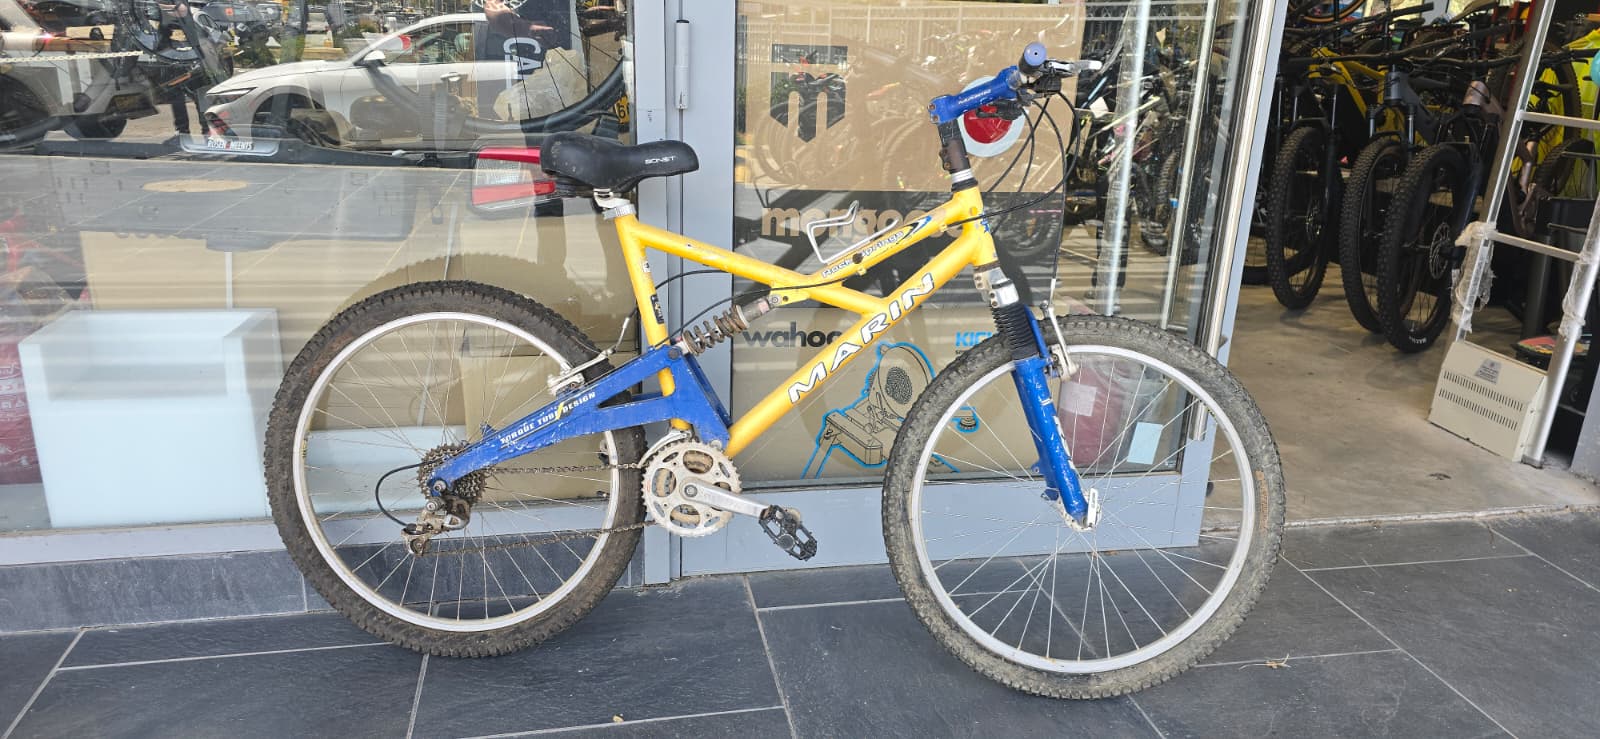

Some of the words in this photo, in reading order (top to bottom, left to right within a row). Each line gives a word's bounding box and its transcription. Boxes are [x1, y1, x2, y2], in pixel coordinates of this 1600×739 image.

[761, 206, 963, 240] mongo
[787, 272, 935, 404] MARIN
[955, 331, 993, 347] KIC
[500, 422, 535, 444] TORQUE
[562, 391, 596, 414] DESIGN
